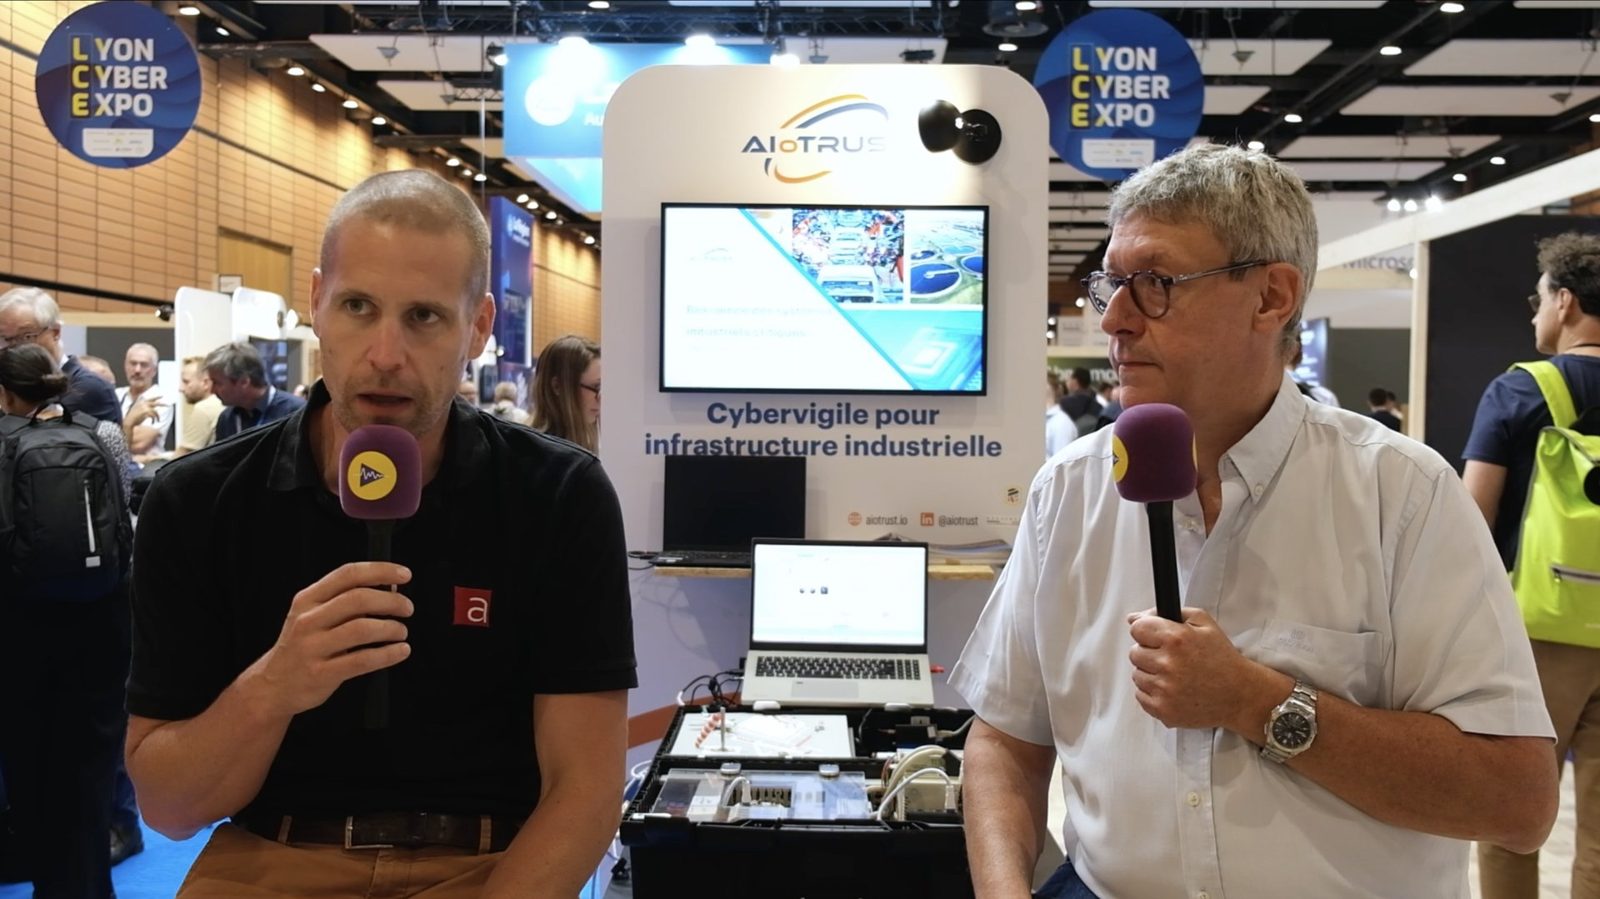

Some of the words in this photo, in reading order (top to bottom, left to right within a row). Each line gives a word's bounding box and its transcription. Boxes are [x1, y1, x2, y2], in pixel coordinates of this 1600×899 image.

[72, 38, 154, 61] LYON
[1072, 47, 1156, 71] LYON
[72, 65, 168, 90] CYBER
[1072, 75, 1170, 99] CYBER
[72, 93, 153, 117] EXPO
[1072, 103, 1155, 127] EXPO
[707, 402, 869, 428] Cybervigile
[875, 406, 940, 428] pour
[645, 433, 838, 456] infrastructure
[845, 435, 1002, 457] industrielle
